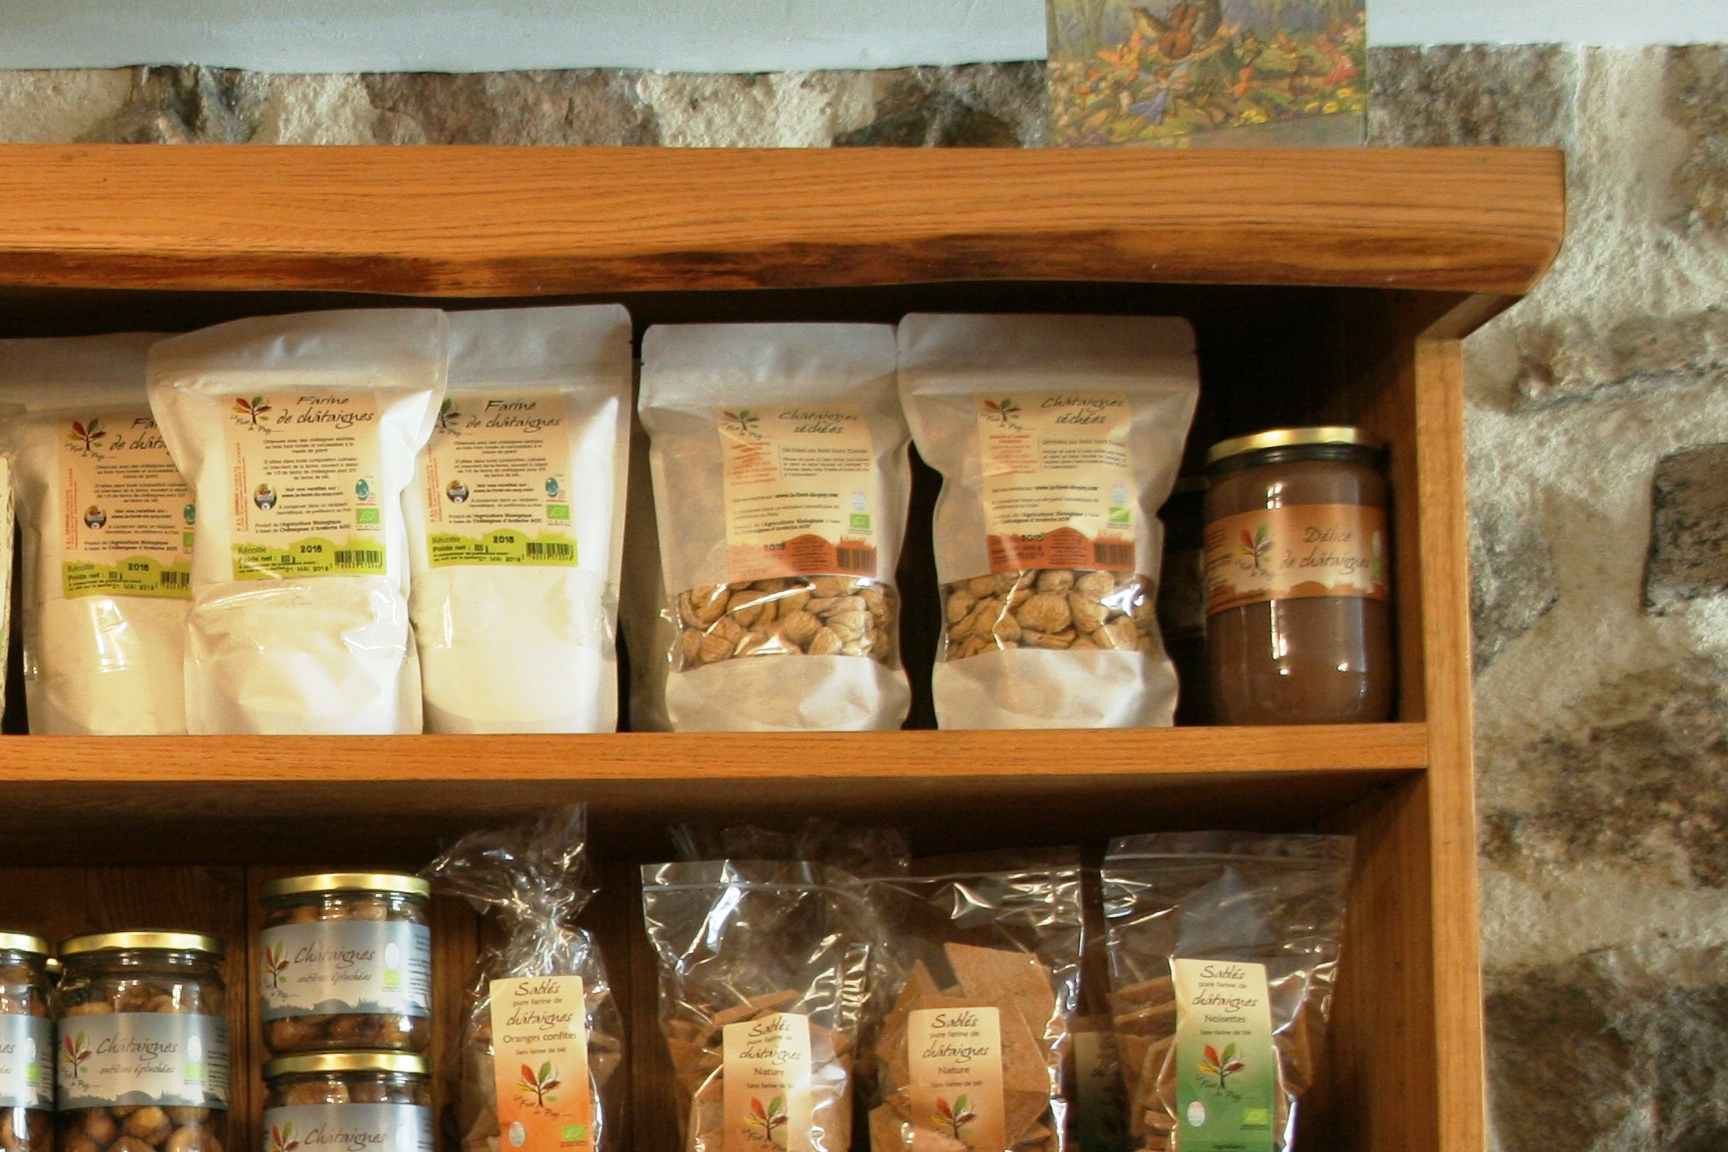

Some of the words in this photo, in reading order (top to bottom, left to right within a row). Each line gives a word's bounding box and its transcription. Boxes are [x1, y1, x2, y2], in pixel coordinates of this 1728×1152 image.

[296, 396, 349, 405] Farine
[484, 399, 537, 413] Farine
[277, 409, 293, 424] de
[297, 407, 374, 429] châtaignes
[465, 416, 481, 429] de
[486, 414, 561, 433] châtaignes
[1303, 524, 1352, 543] Délice
[1200, 965, 1246, 980] Sablés
[514, 979, 561, 996] Sablés
[1191, 989, 1258, 1013] châtaignes
[507, 1007, 574, 1030] châtaignes
[747, 1015, 791, 1037] Sablés
[931, 1011, 980, 1029] Sablés
[1204, 1015, 1247, 1023] Noisettes
[503, 1034, 540, 1045] Oranges
[543, 1032, 577, 1041] confites
[923, 1040, 990, 1063] châtaignes
[938, 1066, 970, 1074] Nature
